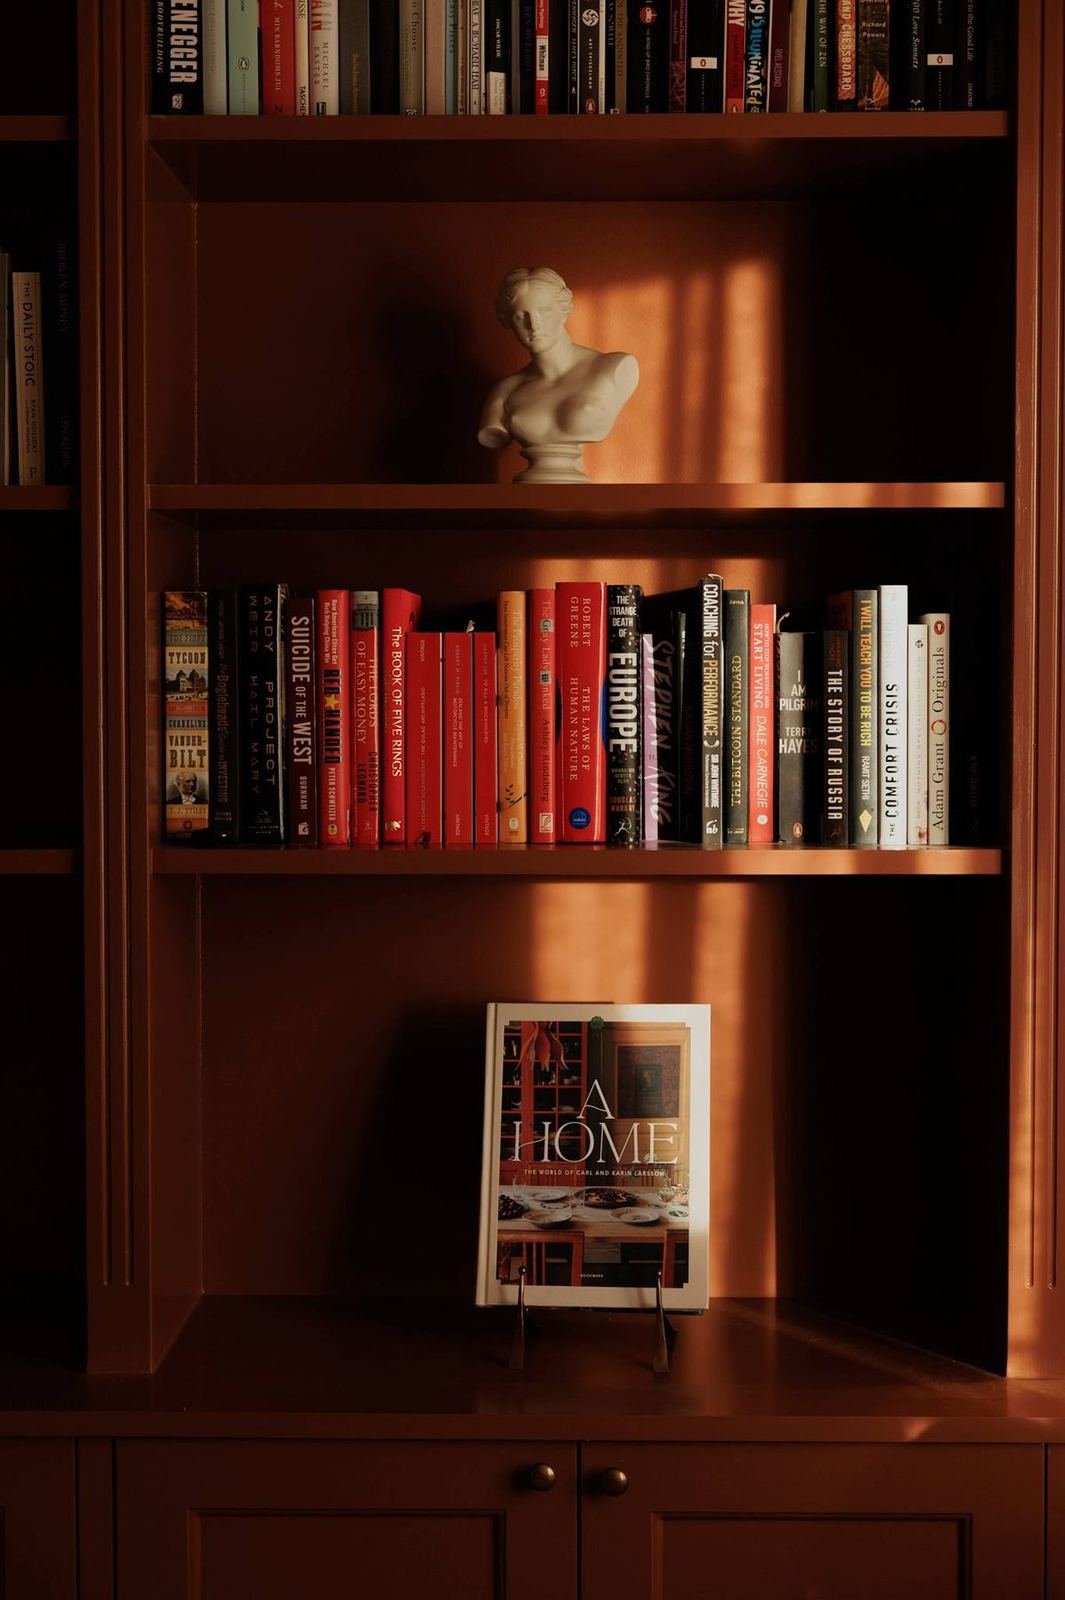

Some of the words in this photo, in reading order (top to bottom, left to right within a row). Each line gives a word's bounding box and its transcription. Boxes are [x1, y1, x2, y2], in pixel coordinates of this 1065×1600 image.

[728, 0, 745, 27] WHY
[818, 0, 827, 14] THE
[967, 14, 975, 25] the
[410, 12, 420, 54] Choose
[818, 17, 827, 34] WAY
[912, 15, 920, 36] Love
[818, 37, 827, 48] OF
[841, 24, 851, 91] CHESSBOARD
[911, 37, 921, 69] Sonnets
[966, 48, 974, 62] Life
[538, 45, 547, 72] Whitman
[818, 52, 827, 67] ZEN
[23, 302, 34, 342] DAILY
[24, 345, 36, 387] STOIC
[323, 602, 331, 614] Rich
[542, 600, 551, 617] The
[608, 606, 638, 616] STRANGE
[615, 595, 630, 605] THE
[702, 583, 719, 638] COACHING
[248, 595, 259, 654] WEIR
[264, 595, 274, 653] ANDY
[322, 615, 331, 636] Helping
[569, 596, 580, 649] GREENE
[582, 597, 592, 648] ROBERT
[611, 617, 634, 627] DEATH
[618, 628, 629, 638] OF
[860, 606, 872, 631] WILL
[291, 616, 311, 684] SUICIDE
[323, 636, 331, 652] China
[355, 641, 367, 659] OF
[391, 626, 403, 648] The
[702, 640, 719, 658] for
[753, 623, 764, 662] START
[860, 633, 872, 665] TEACH
[168, 652, 206, 665] TYCOON
[391, 651, 402, 687] BOOK
[541, 647, 551, 670] Lady
[295, 685, 306, 697] OF
[323, 669, 342, 695] RED
[356, 662, 367, 693] EASY
[730, 655, 742, 722] STANDARD
[753, 666, 764, 709] LIVING
[790, 684, 806, 697] AM
[797, 670, 802, 683] I
[827, 669, 843, 694] THE
[860, 667, 872, 689] YOU
[931, 646, 948, 713] Originals
[249, 674, 259, 729] HAIL
[295, 700, 307, 719] THE
[391, 689, 402, 706] OF
[569, 677, 579, 725] HUMAN
[581, 686, 592, 713] THE
[608, 652, 638, 753] EUROPE
[642, 637, 676, 752] STEPHEN
[702, 658, 719, 737] PERFORMANCE
[779, 697, 820, 712] PILGRIM
[860, 690, 872, 703] TO
[885, 683, 899, 737] CRISIS
[356, 698, 367, 745] MONEY
[391, 709, 402, 736] FIVE
[827, 698, 843, 744] STORY
[860, 705, 872, 719] BE
[168, 735, 207, 747] VANDER-
[264, 681, 276, 785] PROJECT
[292, 721, 312, 766] WEST
[323, 709, 342, 764] HANDED
[541, 719, 550, 752] Ashley
[581, 717, 591, 751] LAWS
[756, 715, 768, 746] DALE
[860, 721, 872, 747] RICH
[169, 749, 207, 768] BILT
[391, 739, 402, 777] RINGS
[569, 729, 579, 782] NATURE
[730, 727, 742, 780] BITCOIN
[779, 738, 820, 755] HAYES
[827, 747, 843, 765] OF
[250, 742, 260, 796] MARY
[327, 767, 336, 787] PETER
[581, 755, 591, 772] OF
[756, 748, 768, 808] CARNEGIE
[861, 755, 871, 779] RAMIT
[931, 743, 944, 784] Grant
[299, 775, 308, 811] BURNHAM
[356, 763, 367, 804] LEONARD
[368, 751, 379, 813] CHRISTOPHER
[643, 764, 677, 826] KING
[730, 780, 742, 807] THE
[827, 768, 843, 821] RUSSIA
[861, 779, 871, 801] SETHI
[885, 743, 899, 818] COMFORT
[328, 787, 337, 821] SCHWEIZER
[931, 789, 944, 832] Adam
[576, 1078, 615, 1119] A
[511, 1121, 679, 1164] HOME
